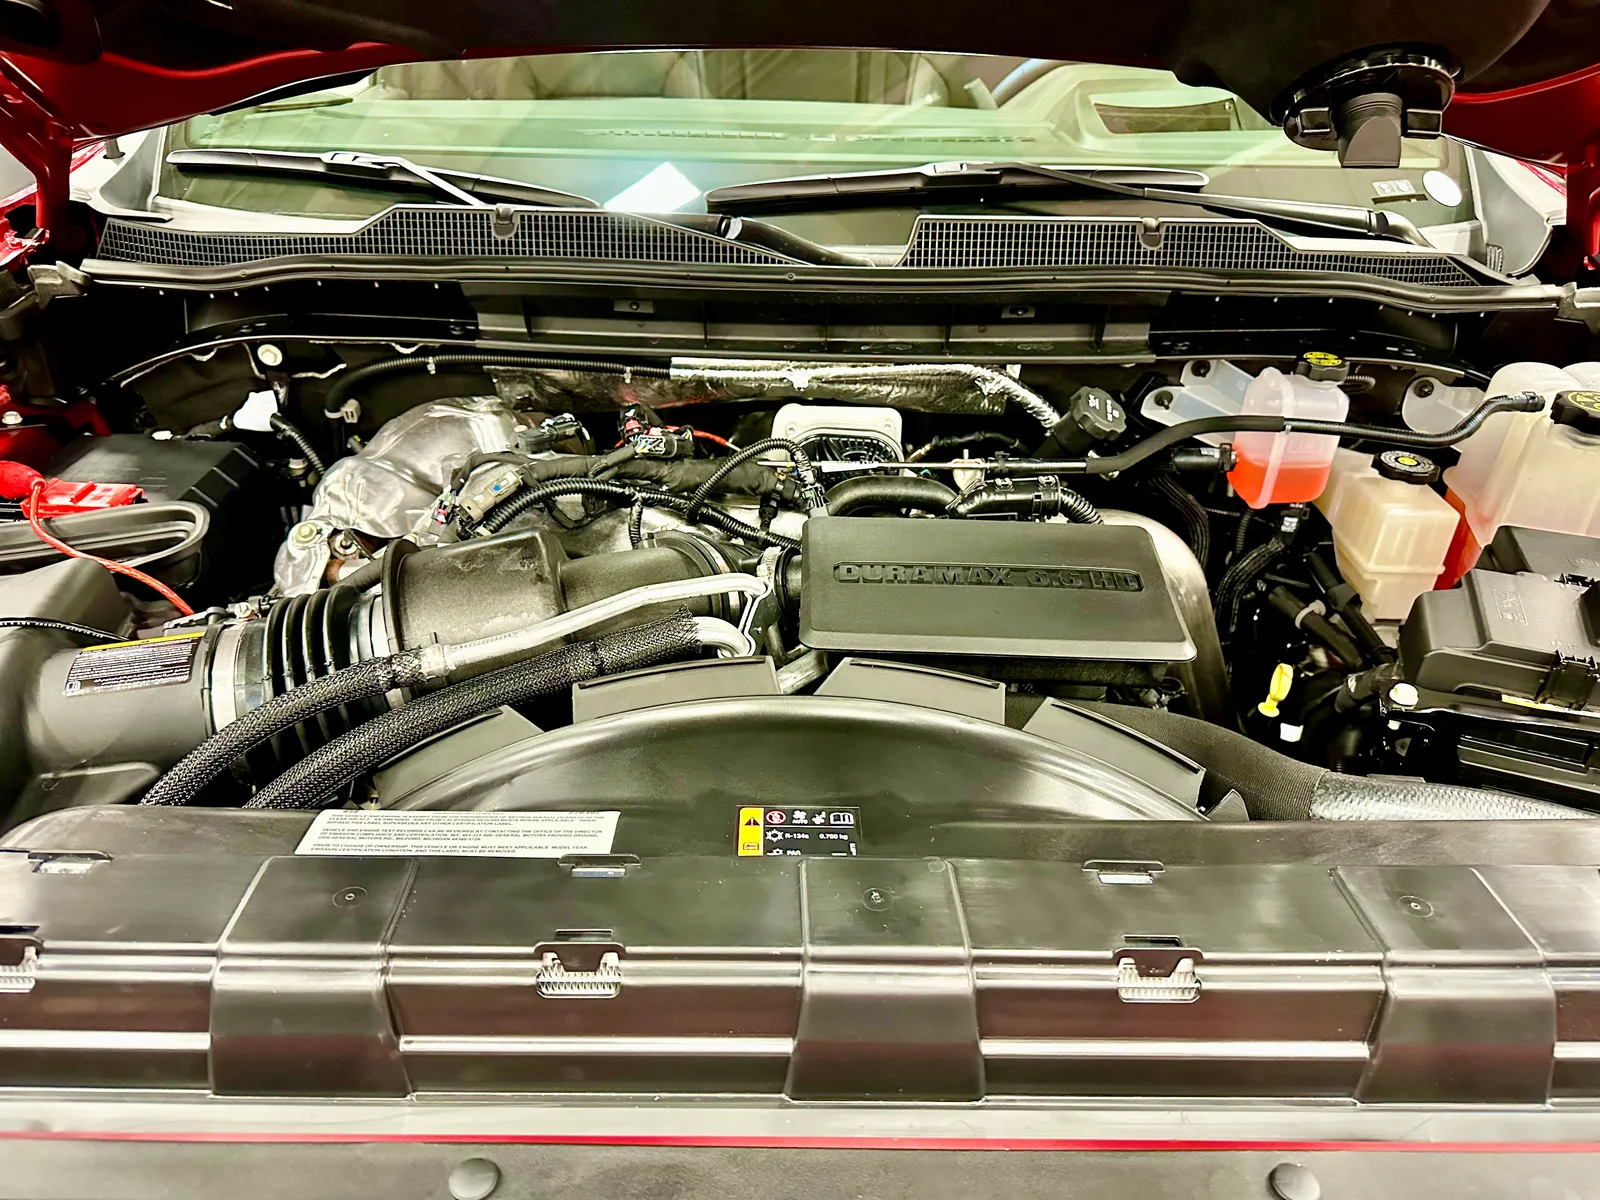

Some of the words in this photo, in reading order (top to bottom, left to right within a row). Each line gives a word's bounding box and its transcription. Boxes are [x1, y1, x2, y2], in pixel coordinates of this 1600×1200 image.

[838, 564, 1012, 585] DURAMAX
[1026, 569, 1083, 587] 6.6
[1089, 571, 1140, 591] HD
